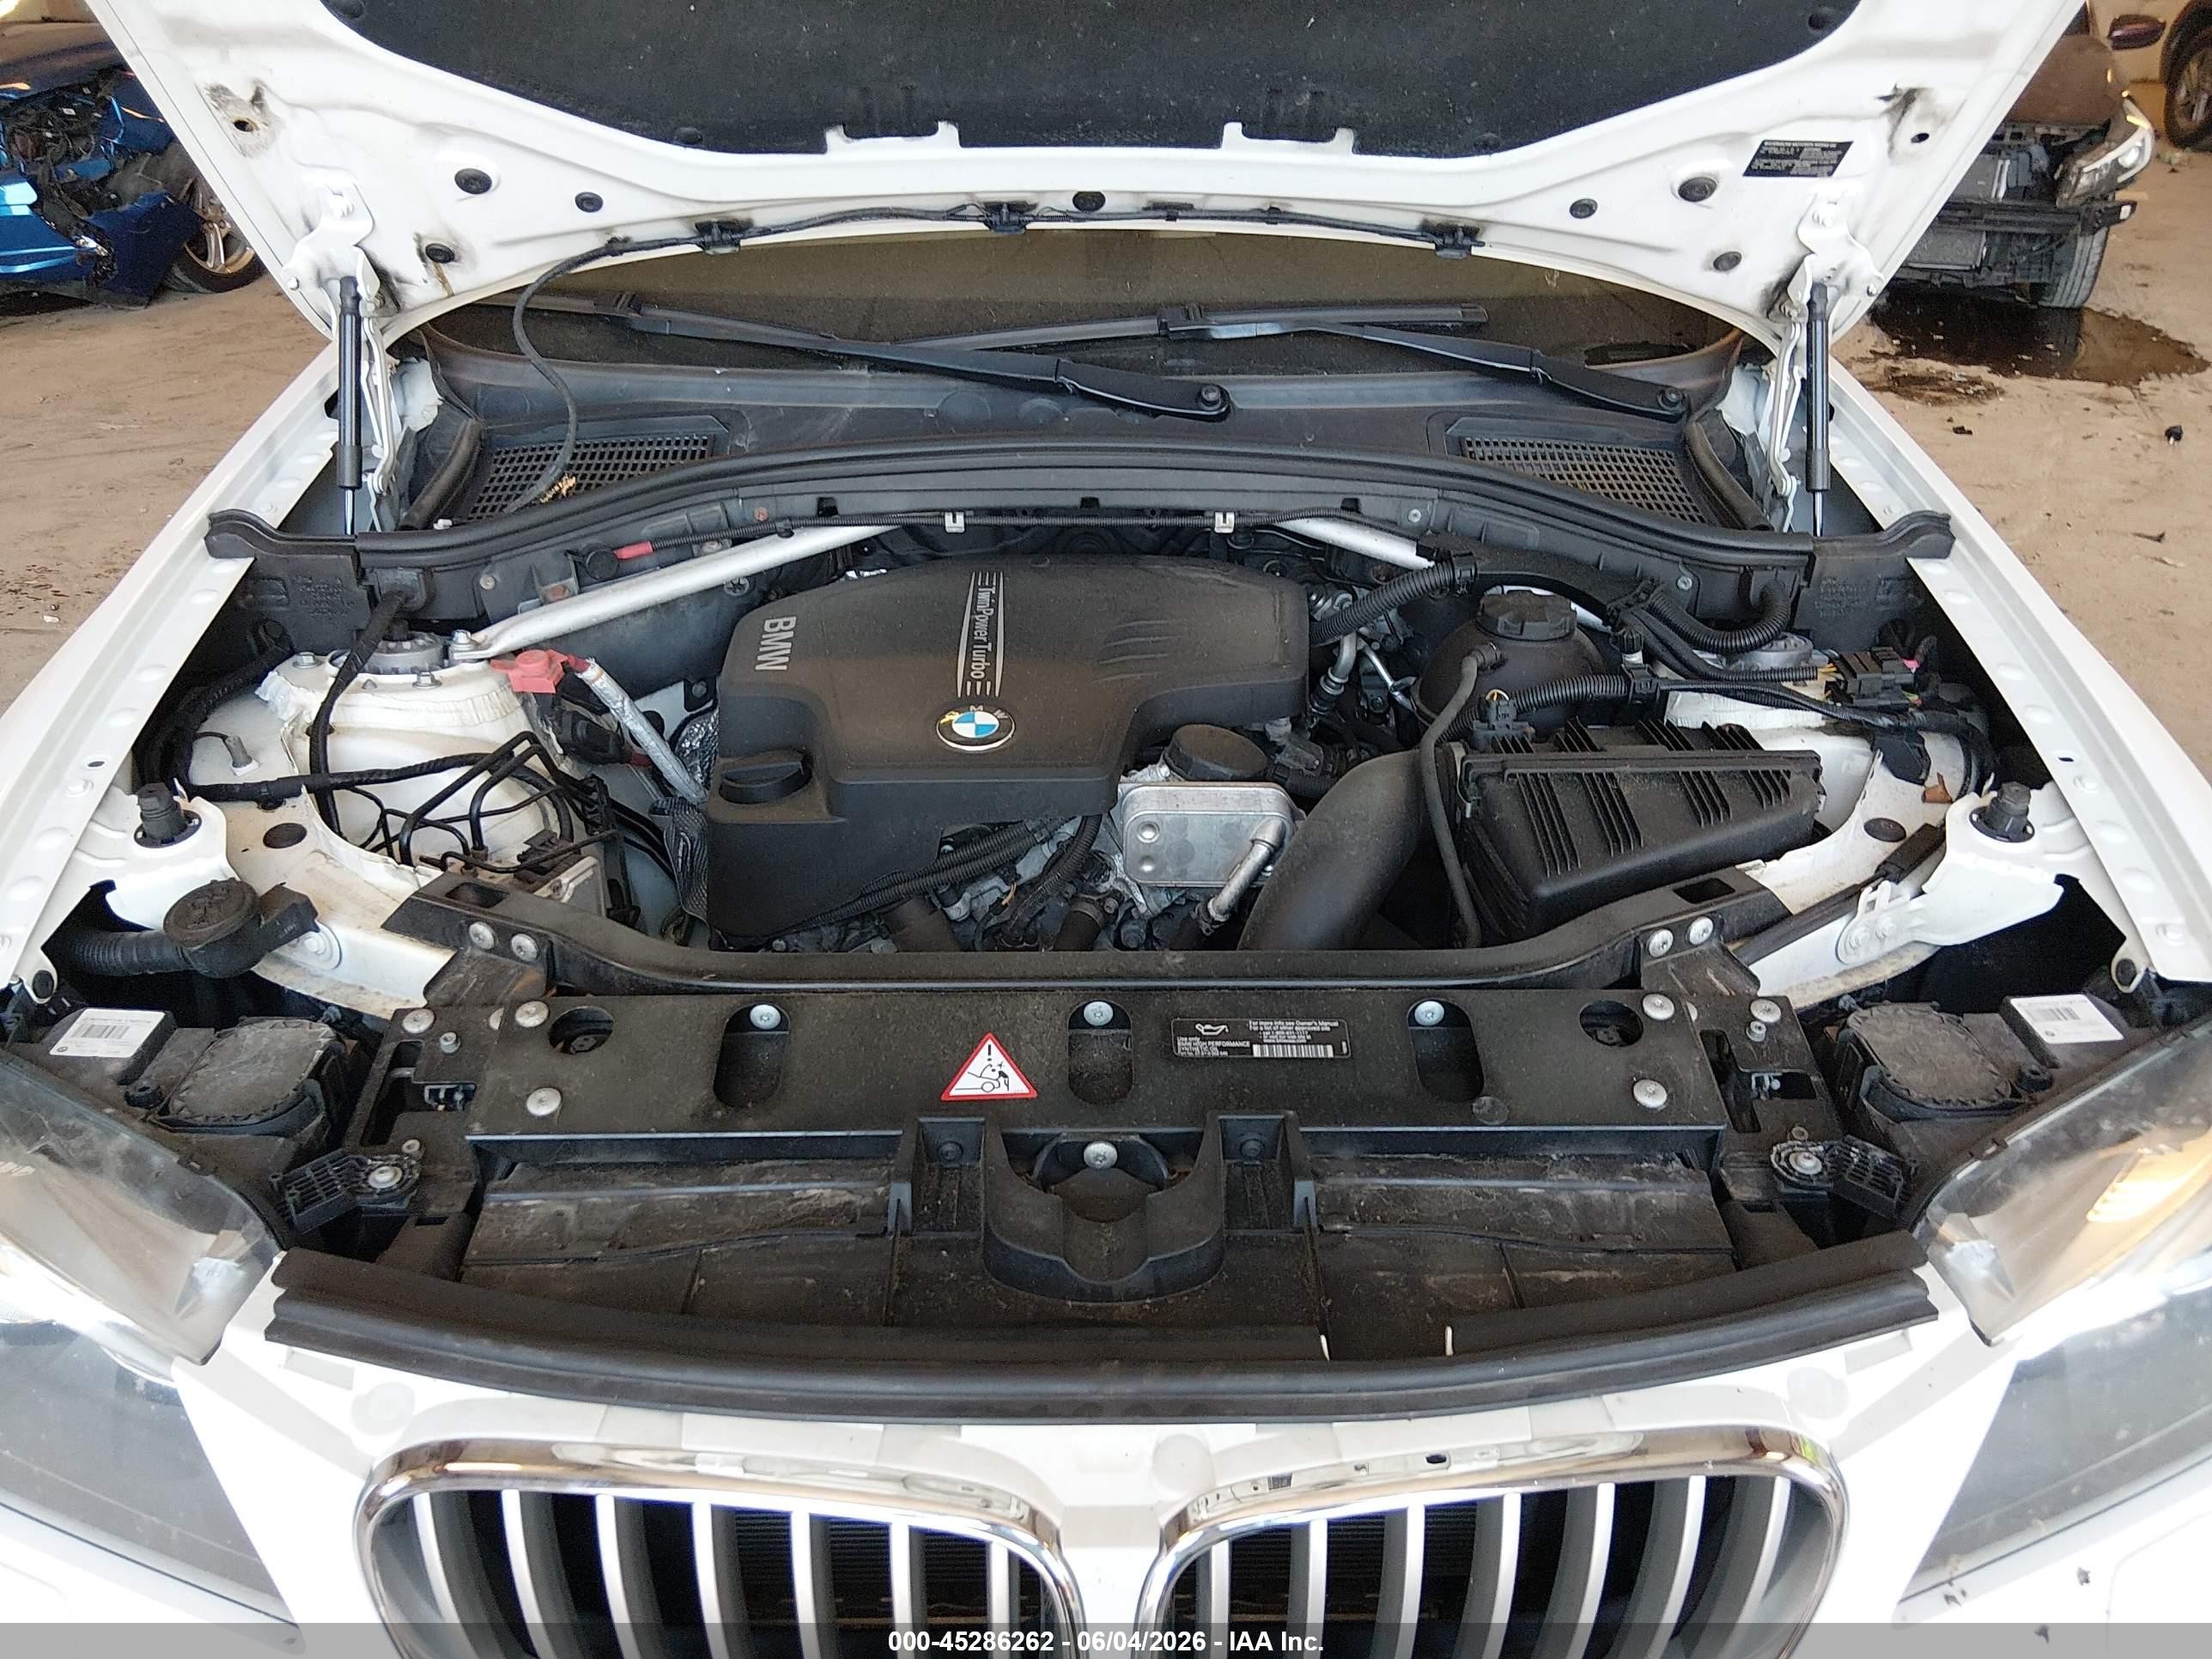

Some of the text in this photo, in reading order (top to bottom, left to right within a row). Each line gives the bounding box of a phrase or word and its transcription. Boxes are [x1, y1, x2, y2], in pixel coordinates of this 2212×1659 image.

[755, 615, 797, 671] BMW
[969, 586, 996, 679] TwinPower Turbo
